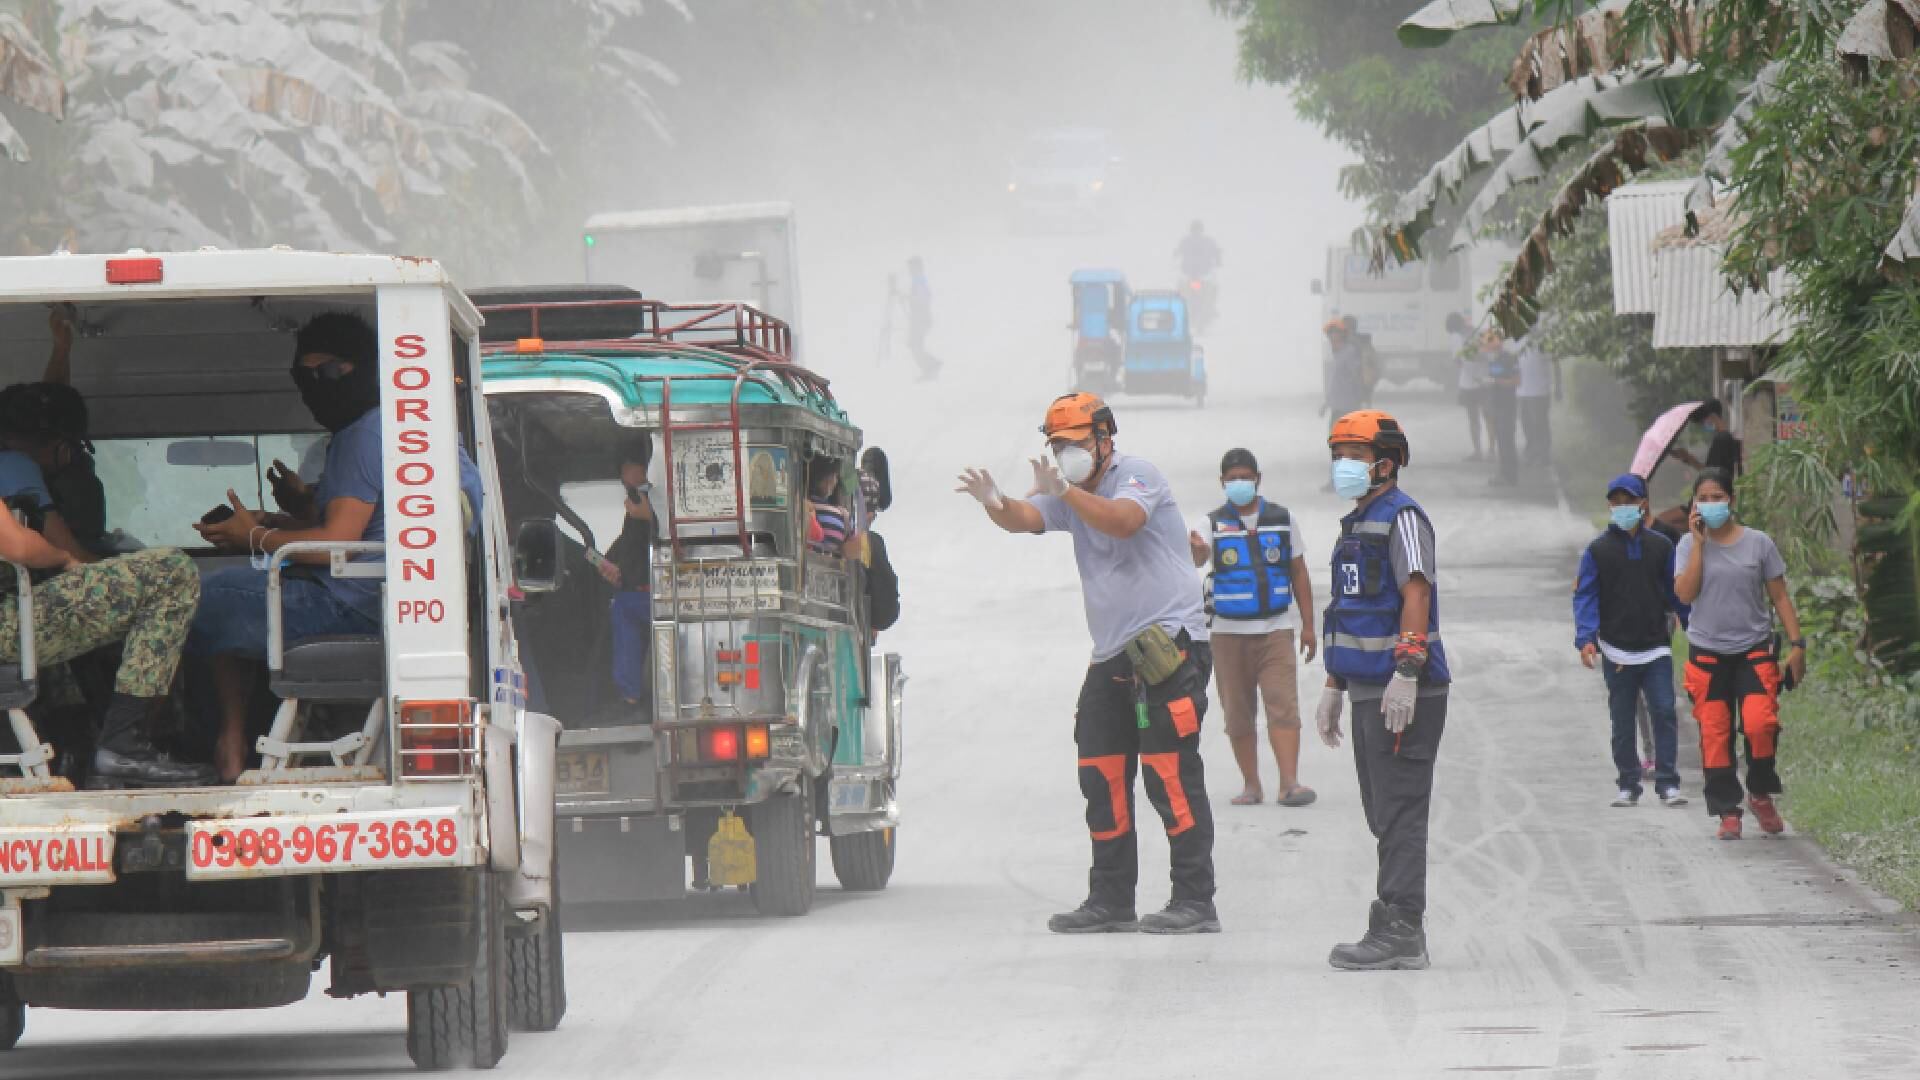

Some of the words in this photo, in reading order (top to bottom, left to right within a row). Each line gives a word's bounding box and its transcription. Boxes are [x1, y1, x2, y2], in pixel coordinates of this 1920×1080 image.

[393, 334, 437, 581] SORSOGON
[398, 599, 444, 624] PPO
[46, 836, 110, 872] CALL
[192, 817, 459, 869] 0998-967-3638
